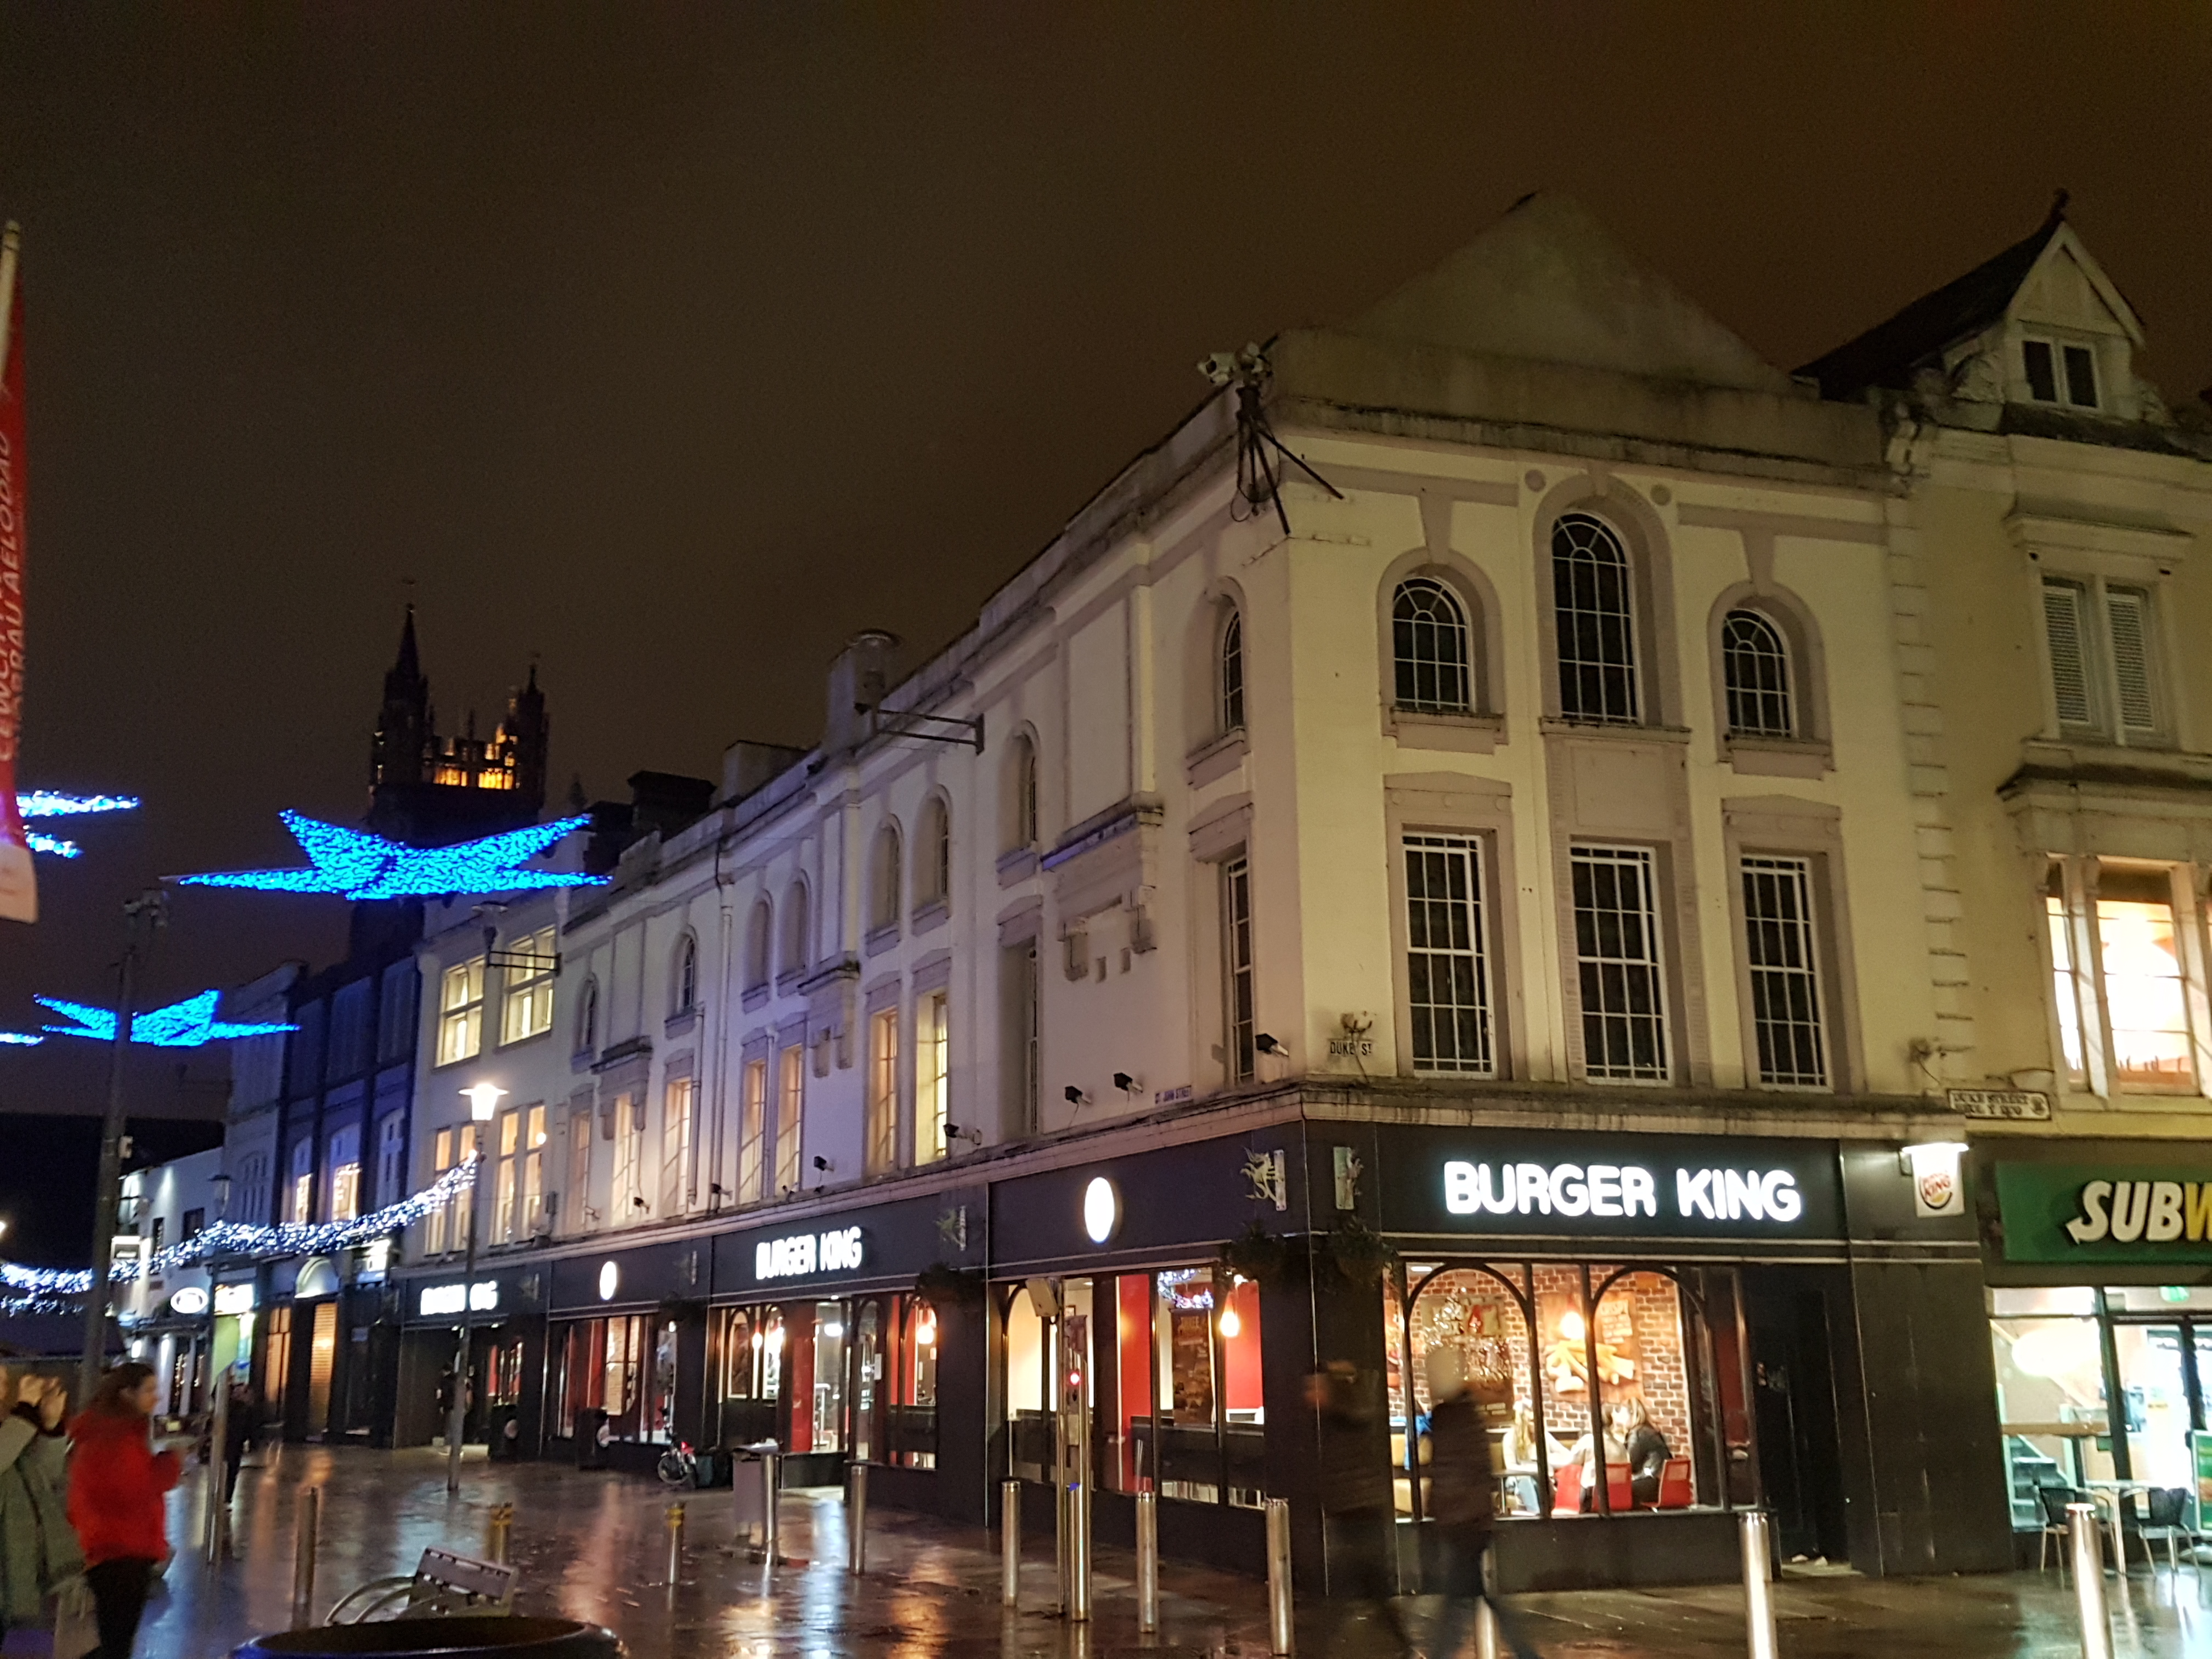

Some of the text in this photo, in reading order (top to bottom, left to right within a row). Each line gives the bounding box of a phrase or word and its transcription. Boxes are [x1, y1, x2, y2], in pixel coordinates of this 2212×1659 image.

[1330, 1042, 1355, 1054] DUKE
[1444, 1161, 1802, 1222] BURGER KING
[755, 1226, 862, 1280] BURGER KING
